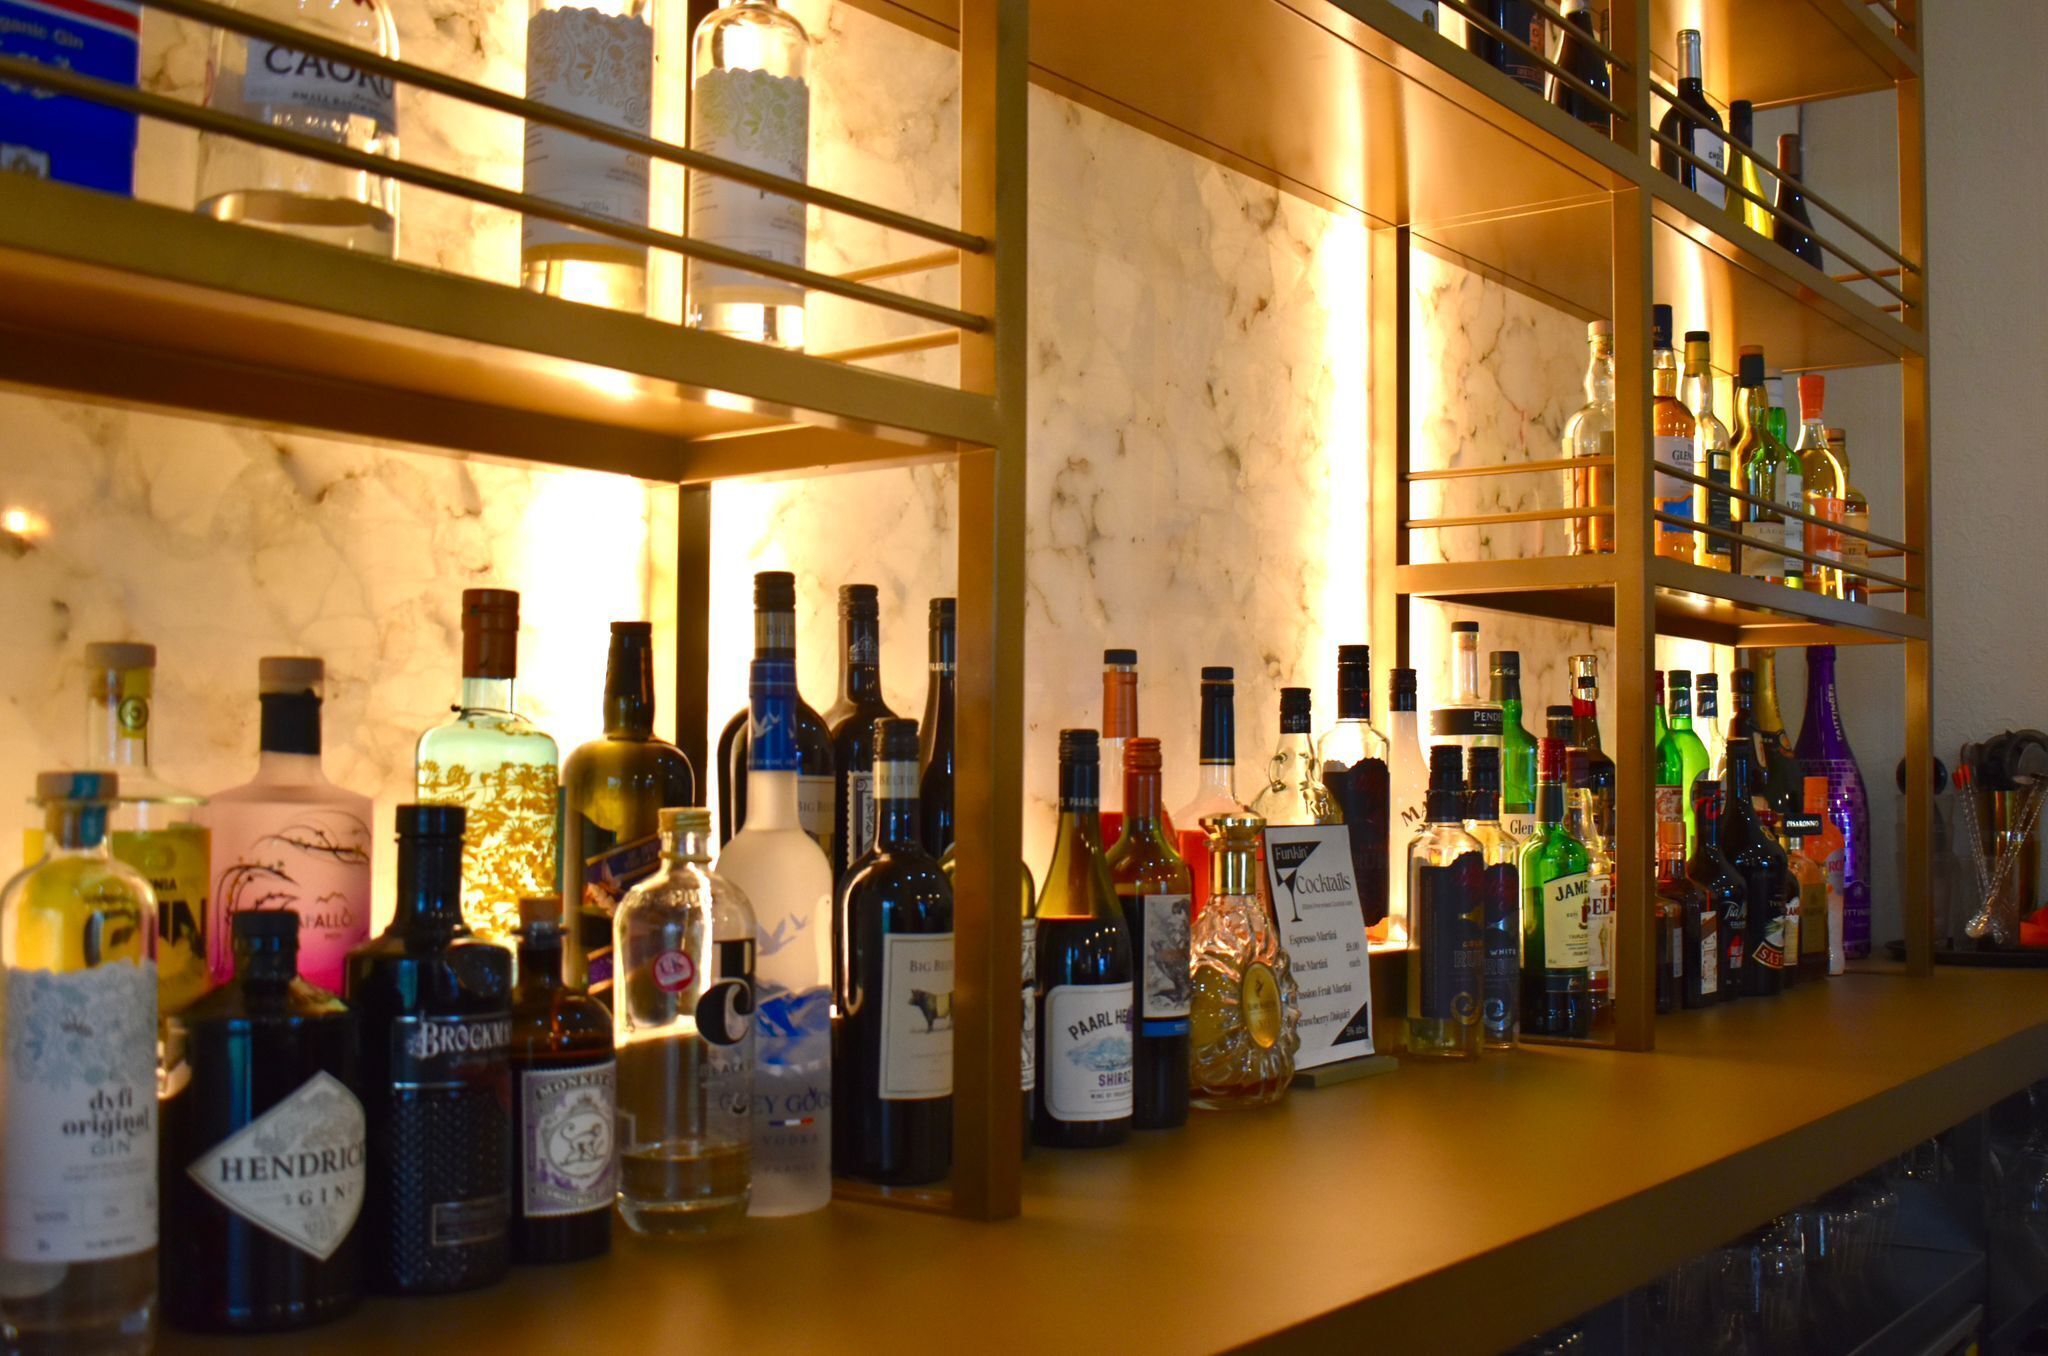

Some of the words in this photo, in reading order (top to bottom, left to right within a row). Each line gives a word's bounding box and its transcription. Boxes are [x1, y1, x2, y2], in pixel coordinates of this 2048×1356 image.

[1829, 682, 1845, 743] TAITTINGER
[1295, 871, 1352, 895] Cocktails
[1289, 934, 1316, 947] Espresso
[1316, 929, 1337, 942] Martini
[1489, 947, 1516, 956] WHITE
[910, 959, 931, 973] BIG
[1307, 957, 1328, 970] Martini
[1297, 989, 1318, 1000] assion
[1068, 1010, 1113, 1041] PAARL
[62, 1106, 149, 1138] original
[299, 1185, 345, 1207] GIN
